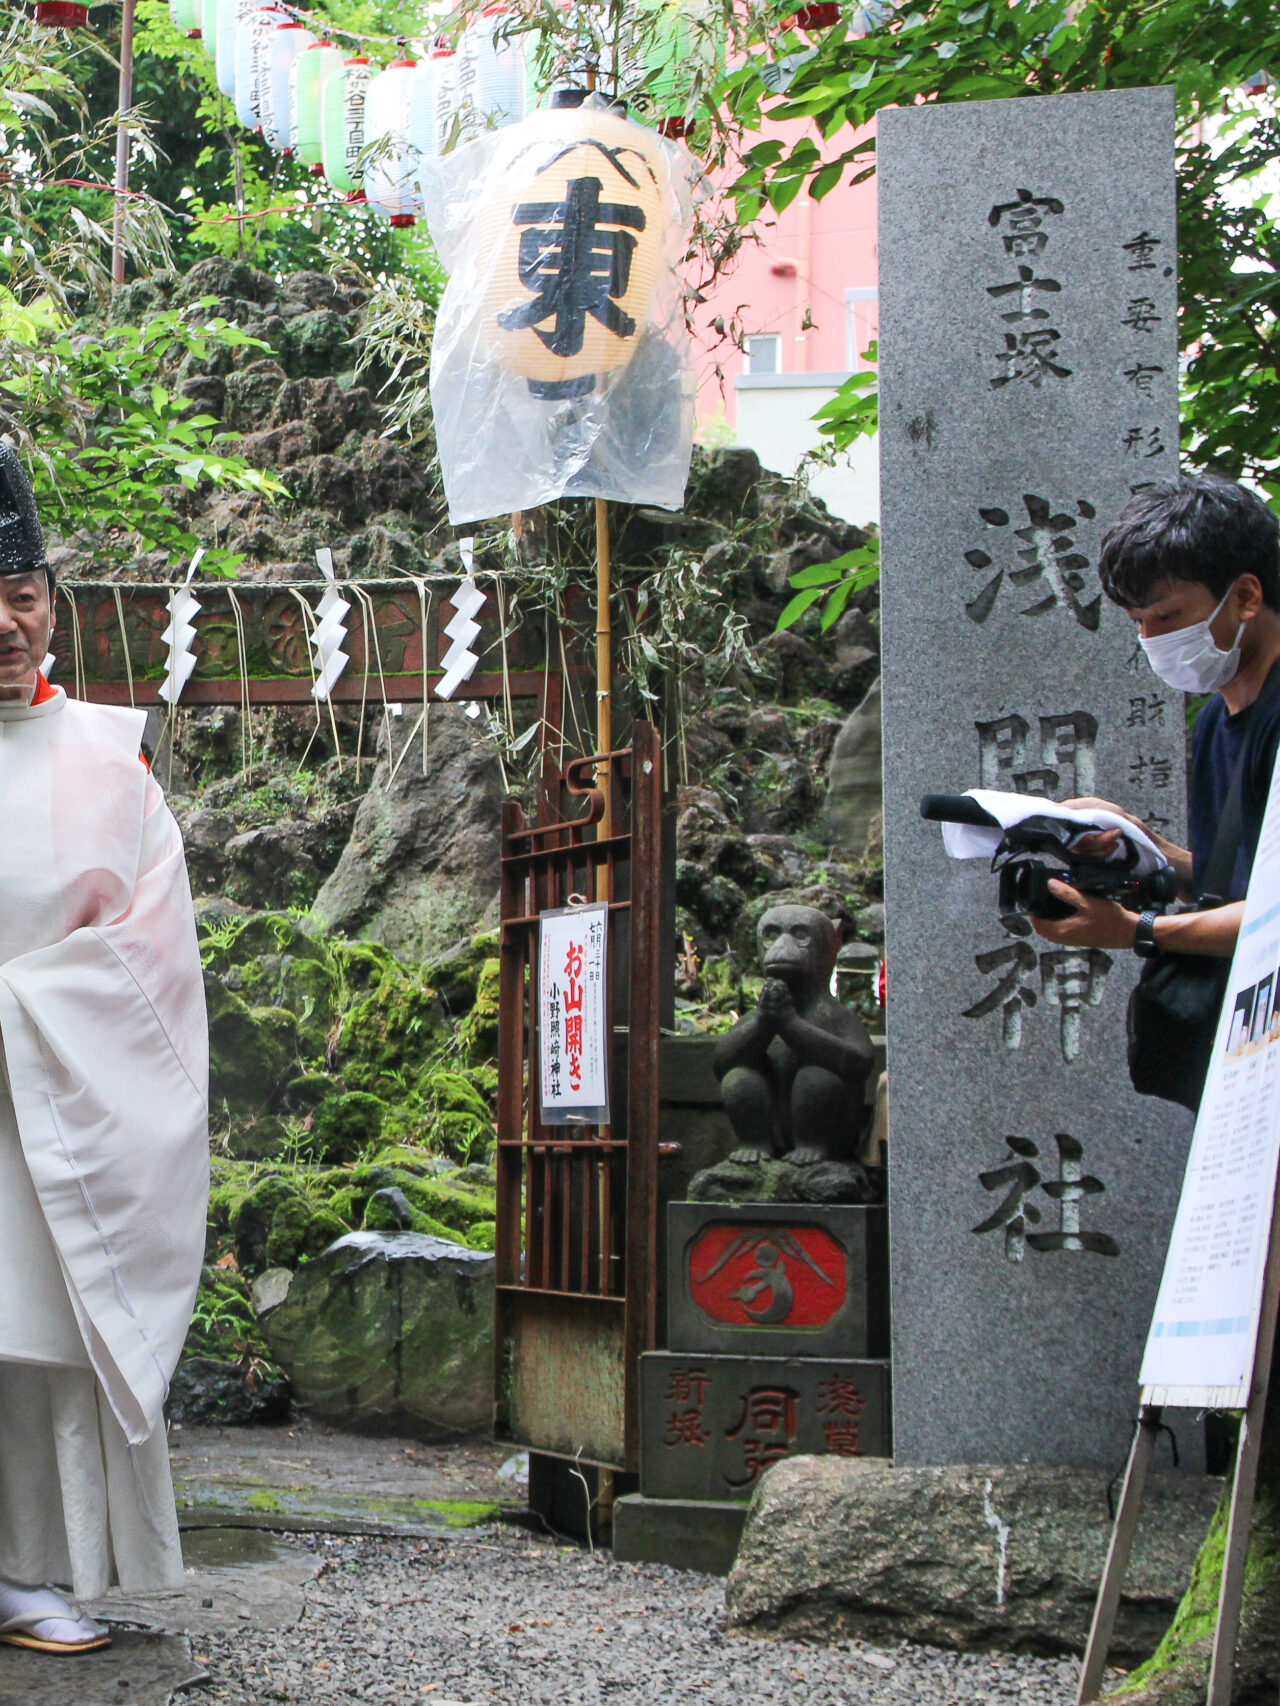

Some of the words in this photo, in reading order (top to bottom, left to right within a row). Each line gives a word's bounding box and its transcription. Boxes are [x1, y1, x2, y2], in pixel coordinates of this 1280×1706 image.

[497, 177, 646, 358] 東
[986, 188, 1073, 391] 富士塚
[563, 940, 583, 1091] お山開き
